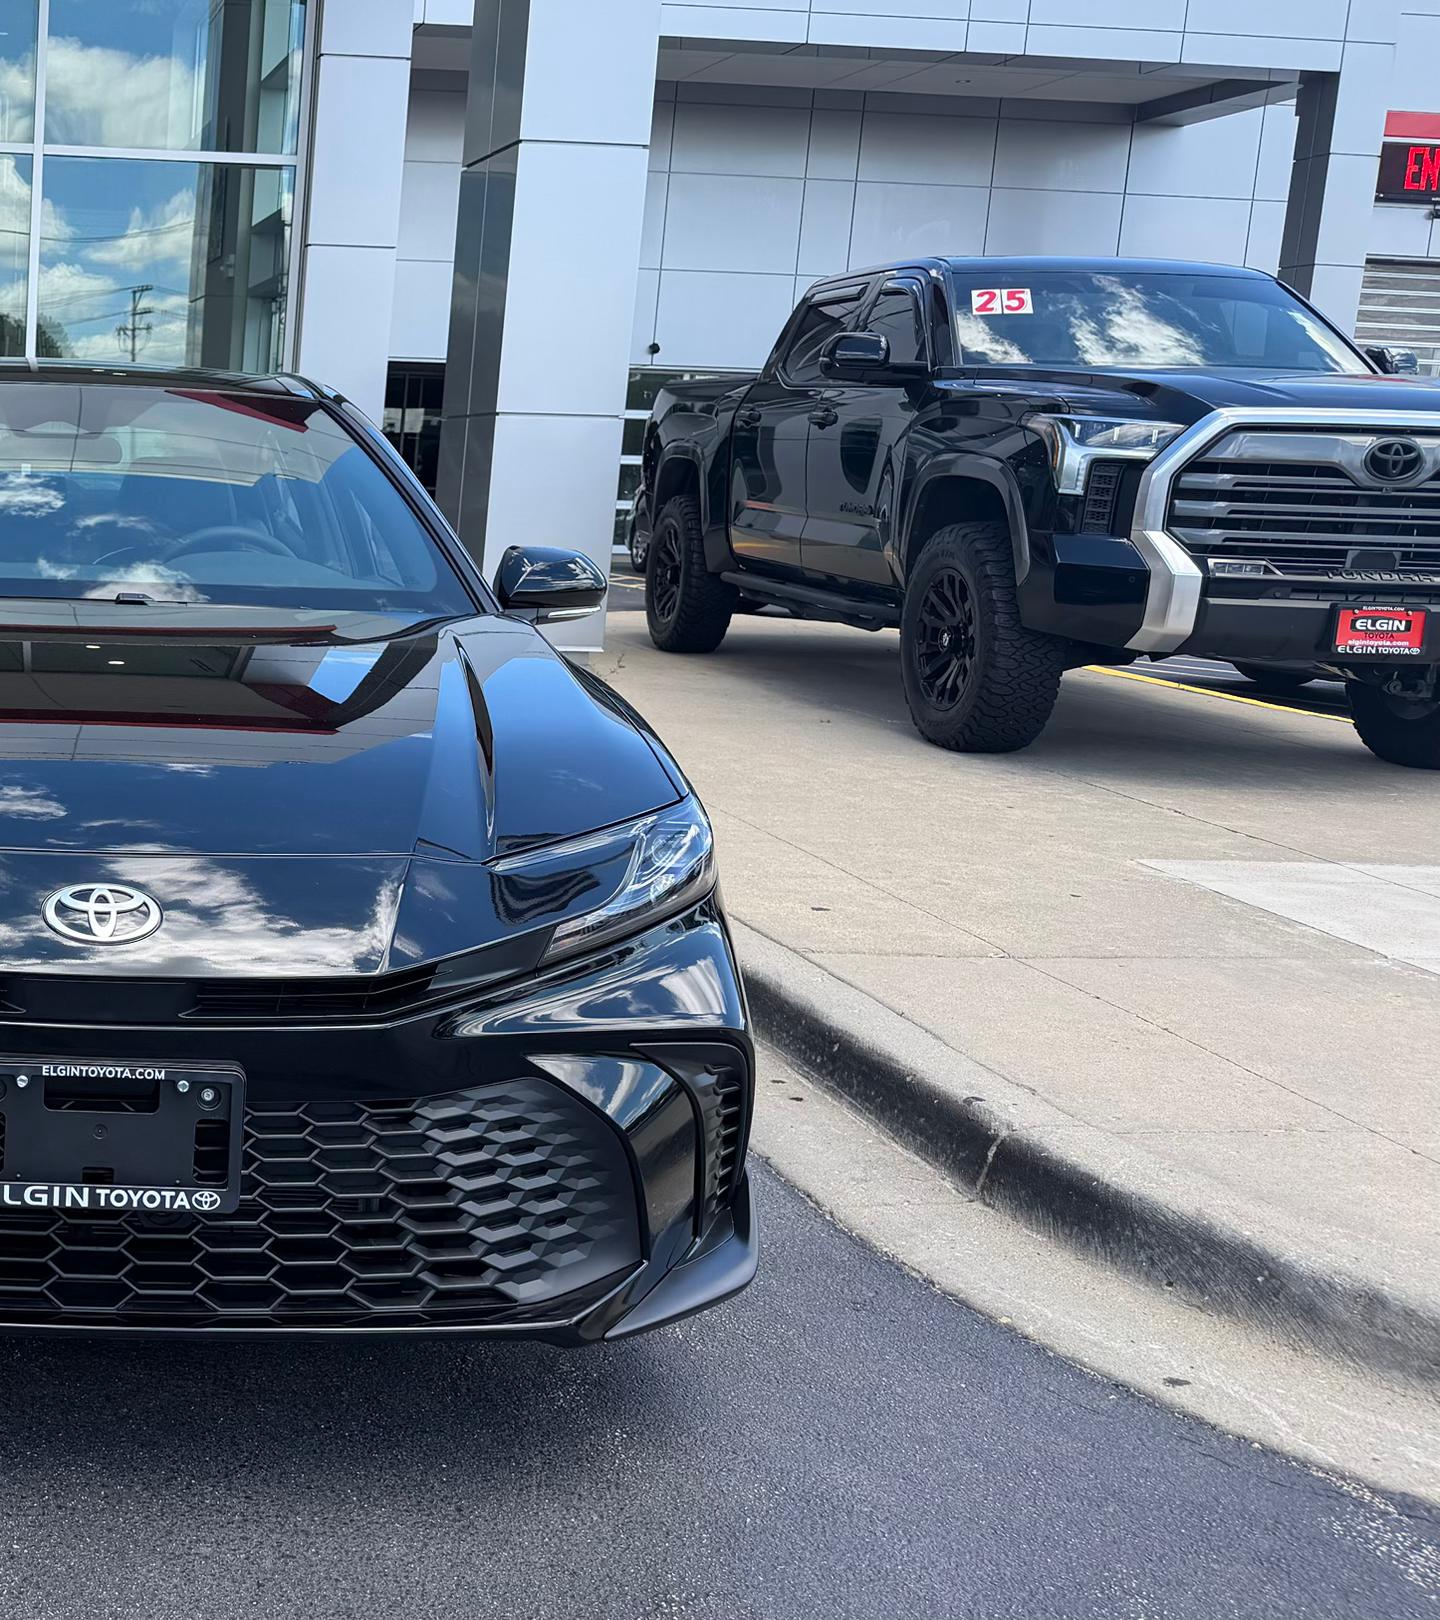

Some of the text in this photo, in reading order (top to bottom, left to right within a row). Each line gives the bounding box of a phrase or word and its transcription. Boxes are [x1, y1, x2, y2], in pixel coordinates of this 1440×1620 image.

[975, 290, 1027, 312] 25
[1355, 619, 1406, 631] ELGIN
[1337, 645, 1410, 655] ELGIN TOYOTA
[42, 1065, 165, 1081] ELGINTOYOTA.COM
[95, 1188, 191, 1210] TOYOTA
